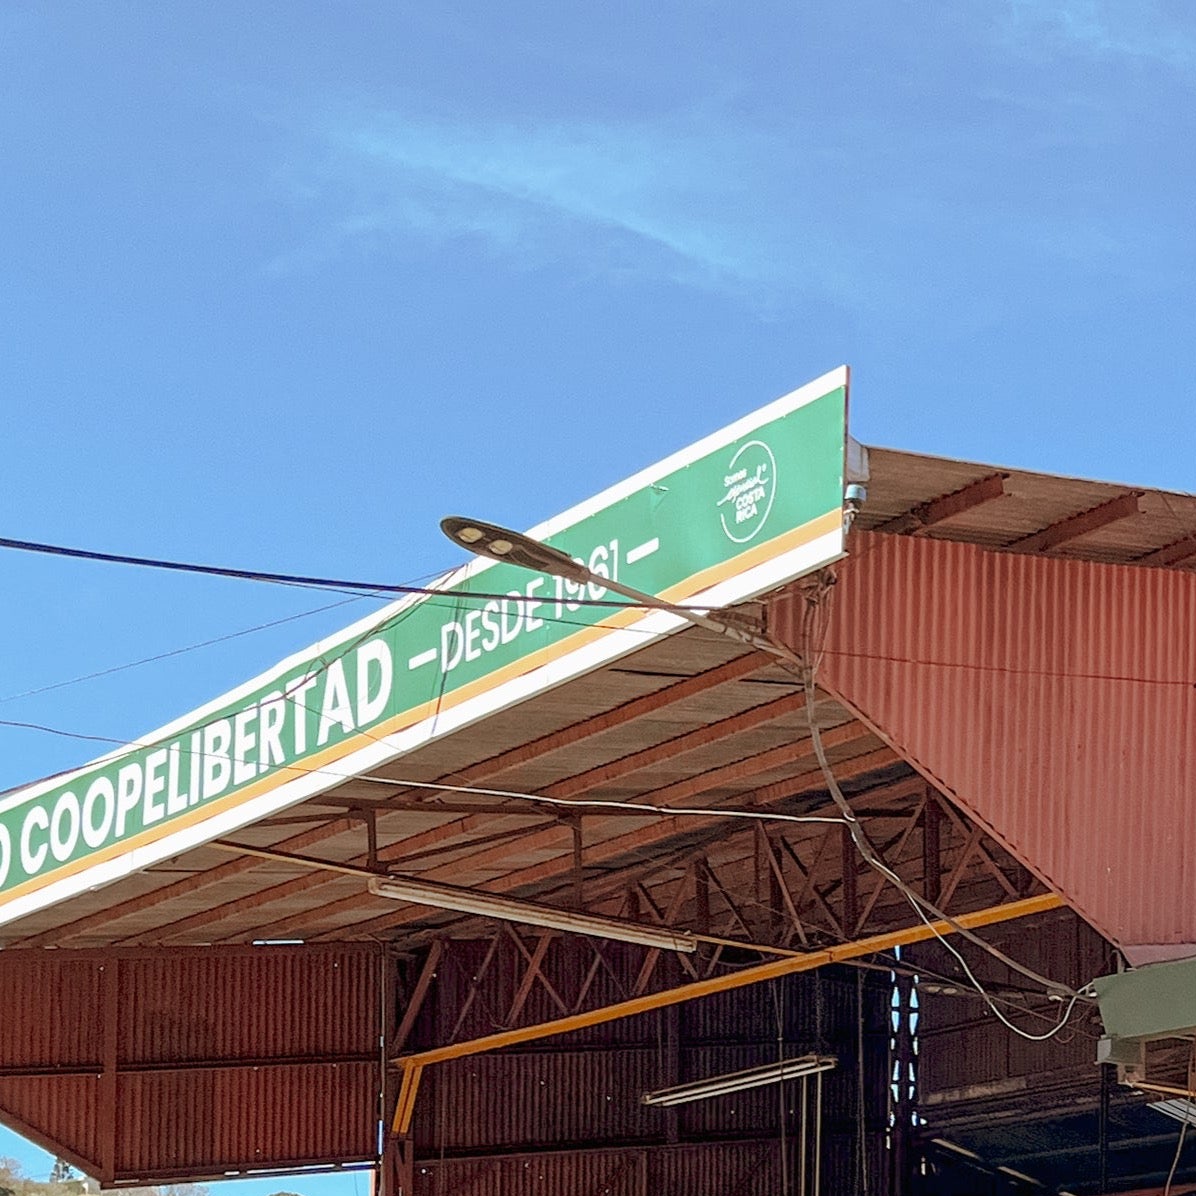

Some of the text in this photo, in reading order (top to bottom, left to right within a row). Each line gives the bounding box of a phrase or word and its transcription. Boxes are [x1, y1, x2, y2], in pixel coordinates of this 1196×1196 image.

[20, 638, 393, 875] COOPELIBERTAD
[441, 577, 544, 674] DESDE
[552, 539, 618, 619] 1961
